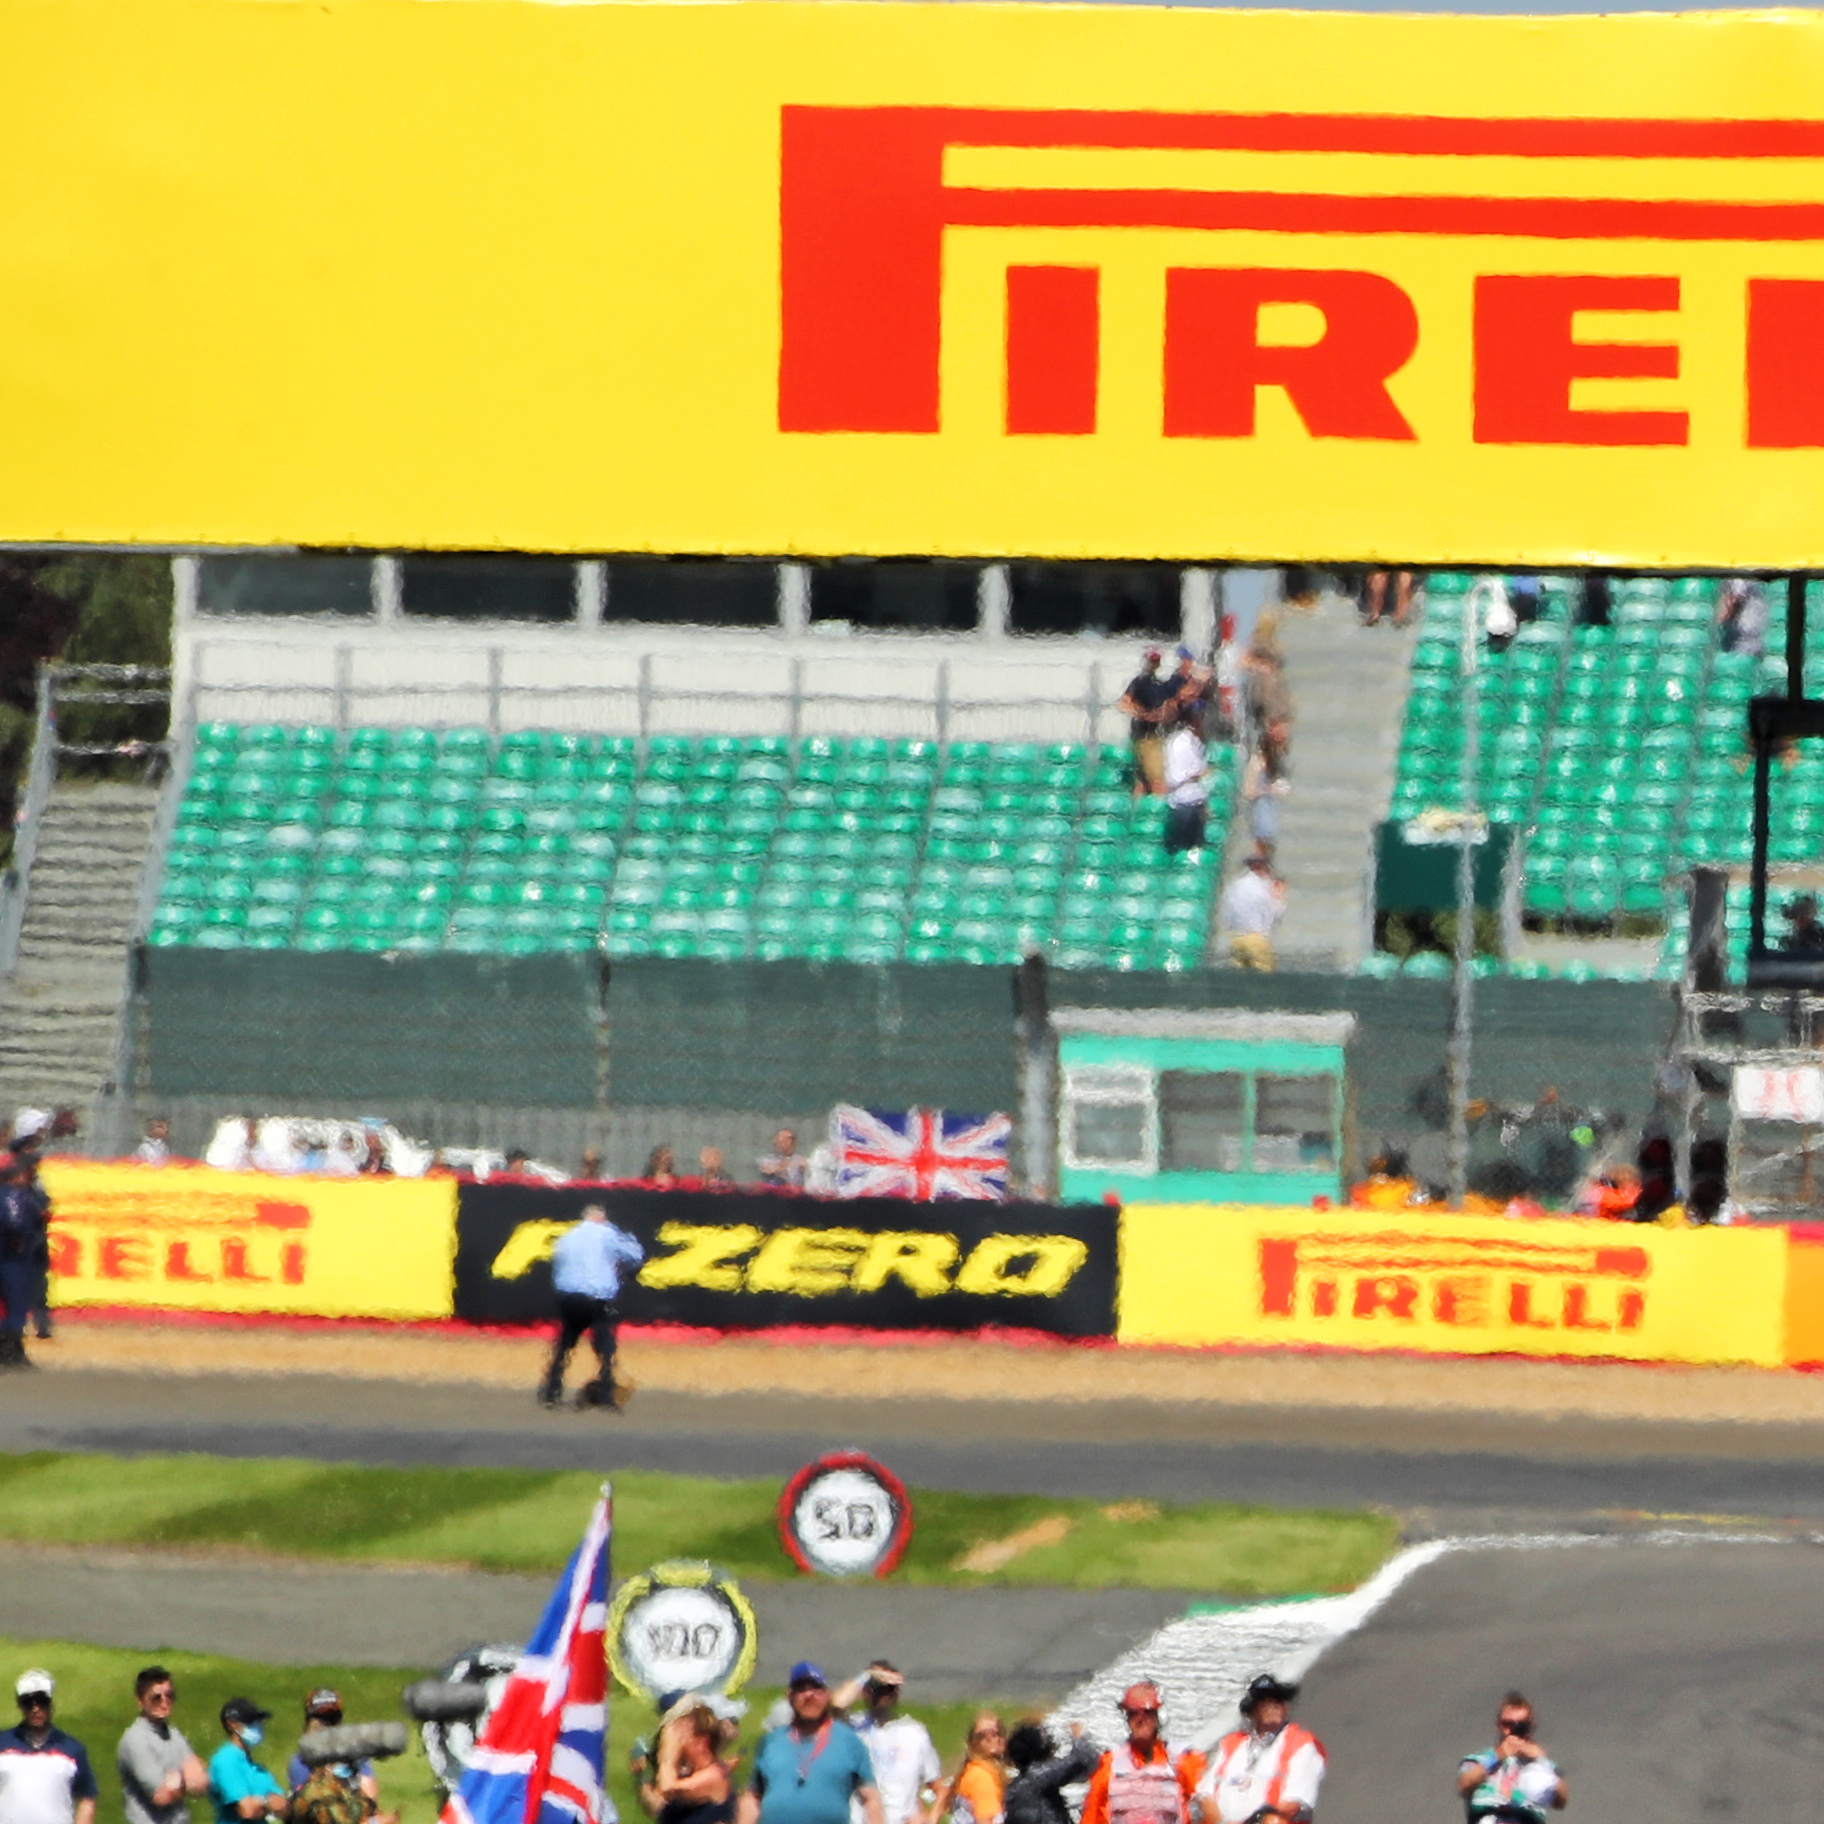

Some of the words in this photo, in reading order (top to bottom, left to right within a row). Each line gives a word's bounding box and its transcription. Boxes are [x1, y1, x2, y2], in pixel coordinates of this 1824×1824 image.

[637, 1222, 1090, 1299] ZERO
[1259, 1233, 1649, 1331] PIRELLI
[814, 1498, 876, 1541] 50
